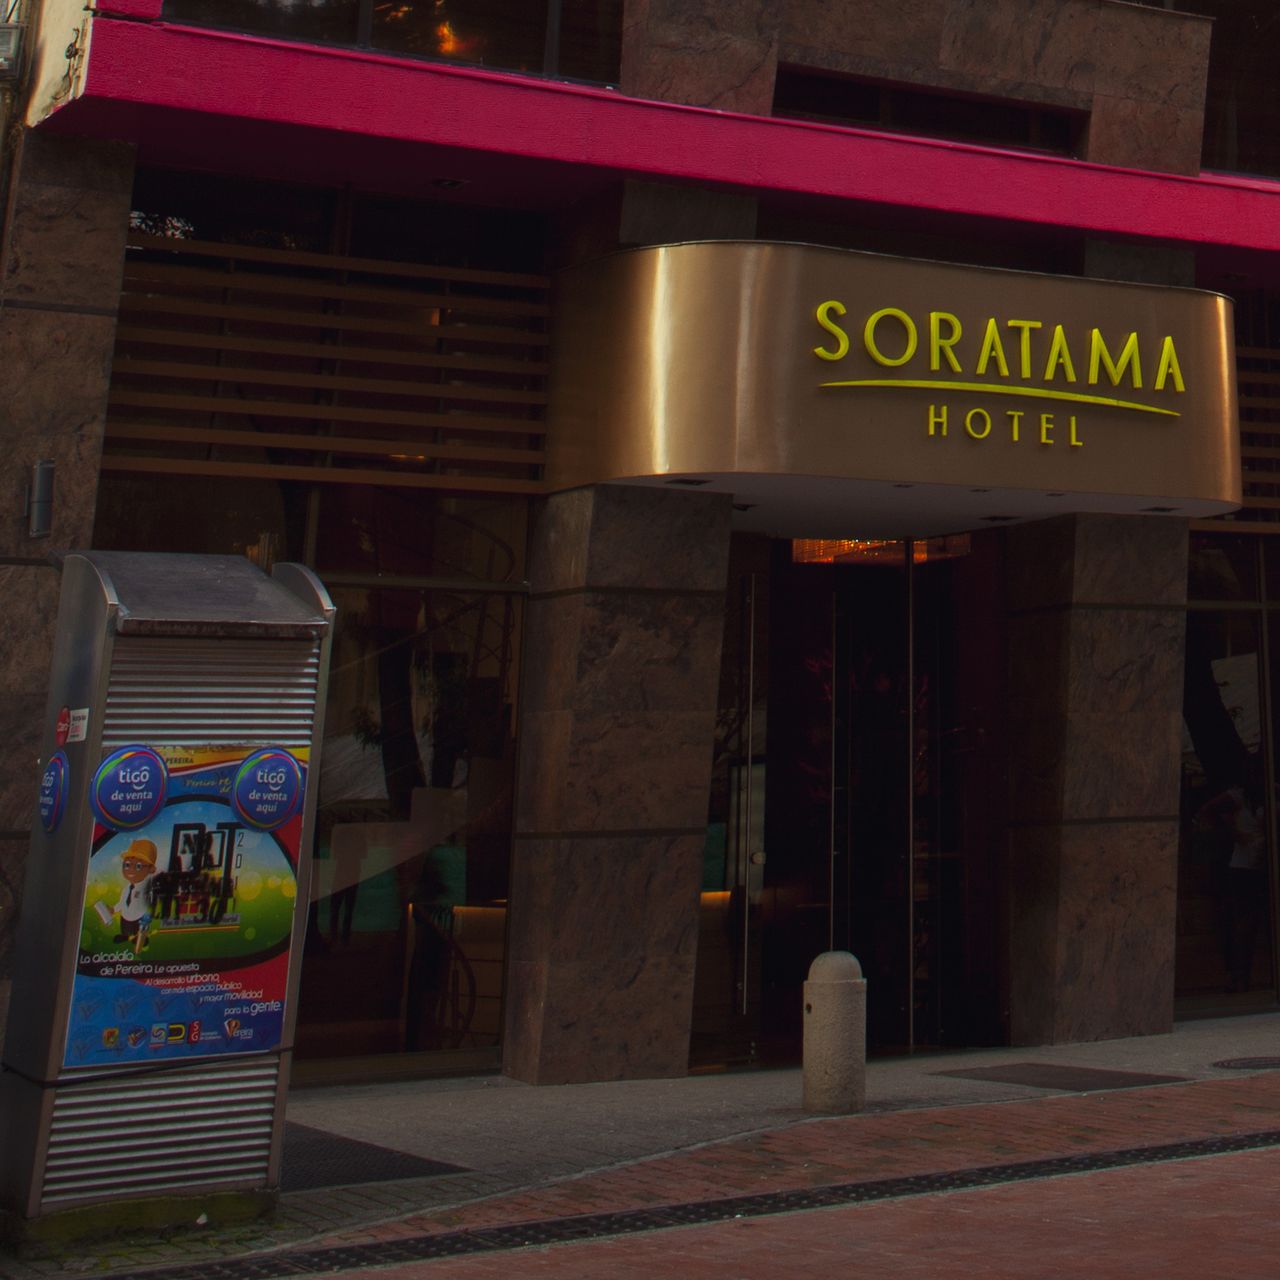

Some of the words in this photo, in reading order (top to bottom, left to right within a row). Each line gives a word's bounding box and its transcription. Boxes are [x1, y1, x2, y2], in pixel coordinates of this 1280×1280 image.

[813, 300, 1187, 393] SORATAMA
[928, 404, 1084, 447] HOTEL
[111, 790, 124, 801] de
[126, 790, 152, 801] venta
[248, 789, 261, 801] de
[262, 790, 288, 801] venta
[119, 801, 142, 814] aquí
[255, 801, 278, 814] aquí
[100, 966, 114, 976] de
[115, 963, 153, 975] Pereira
[154, 965, 165, 974] Le
[224, 989, 264, 1001] movilidad
[224, 1006, 242, 1017] para
